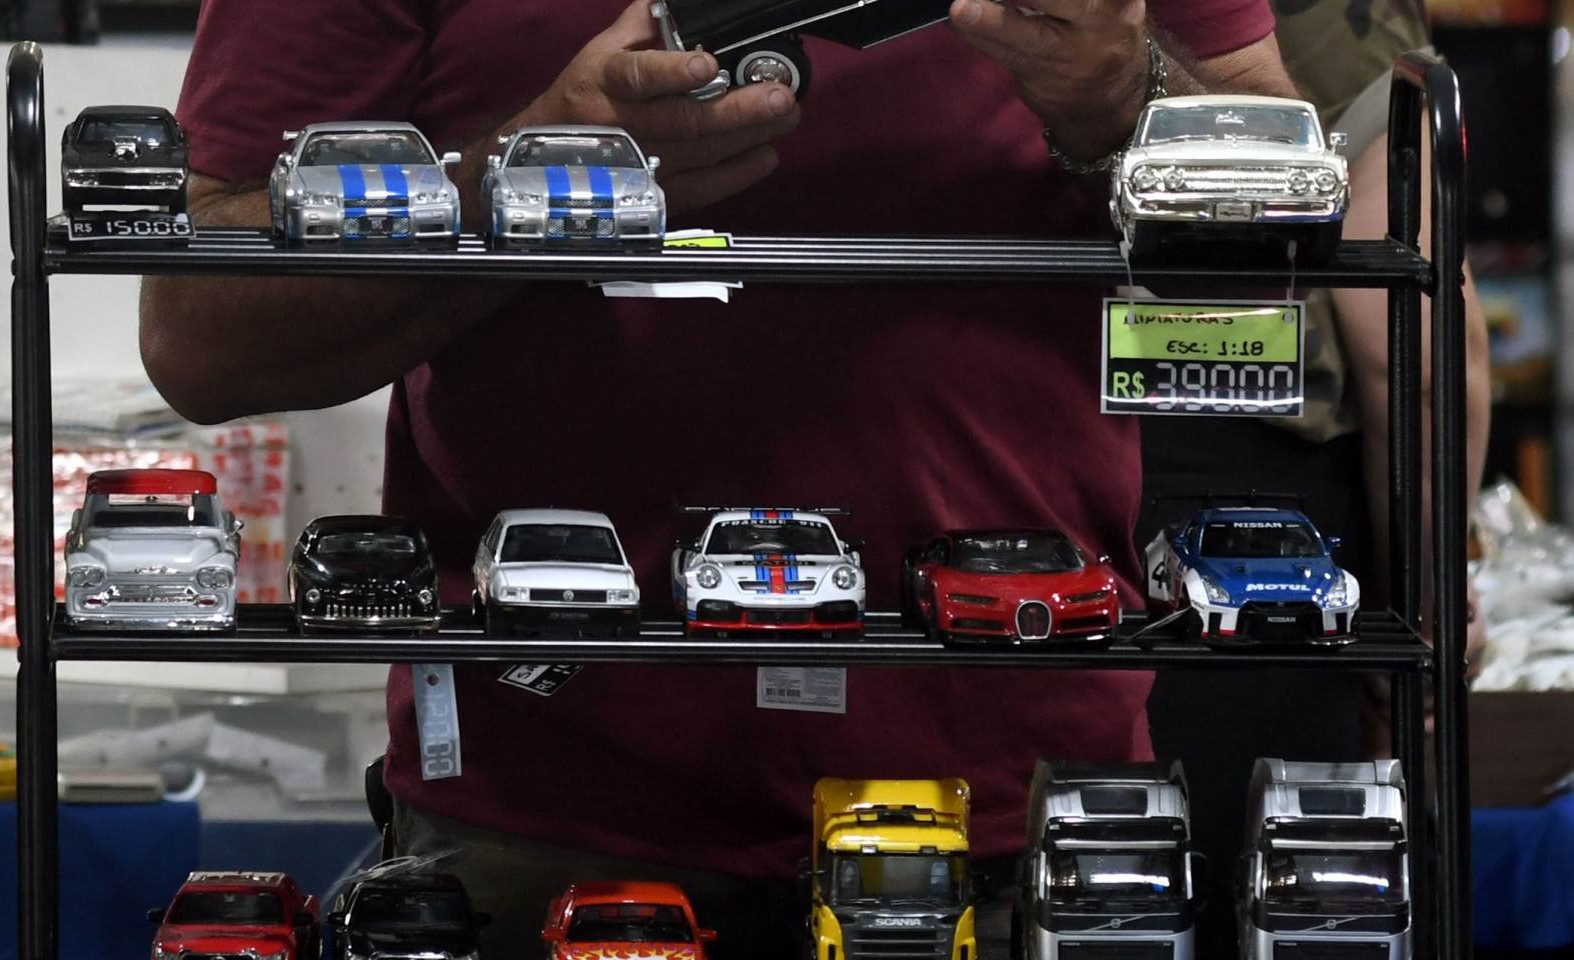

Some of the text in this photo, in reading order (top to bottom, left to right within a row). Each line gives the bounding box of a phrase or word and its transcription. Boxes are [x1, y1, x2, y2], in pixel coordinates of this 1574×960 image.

[1112, 371, 1146, 400] R$
[1246, 583, 1311, 592] MOTUL
[875, 918, 921, 926] SCANIA
